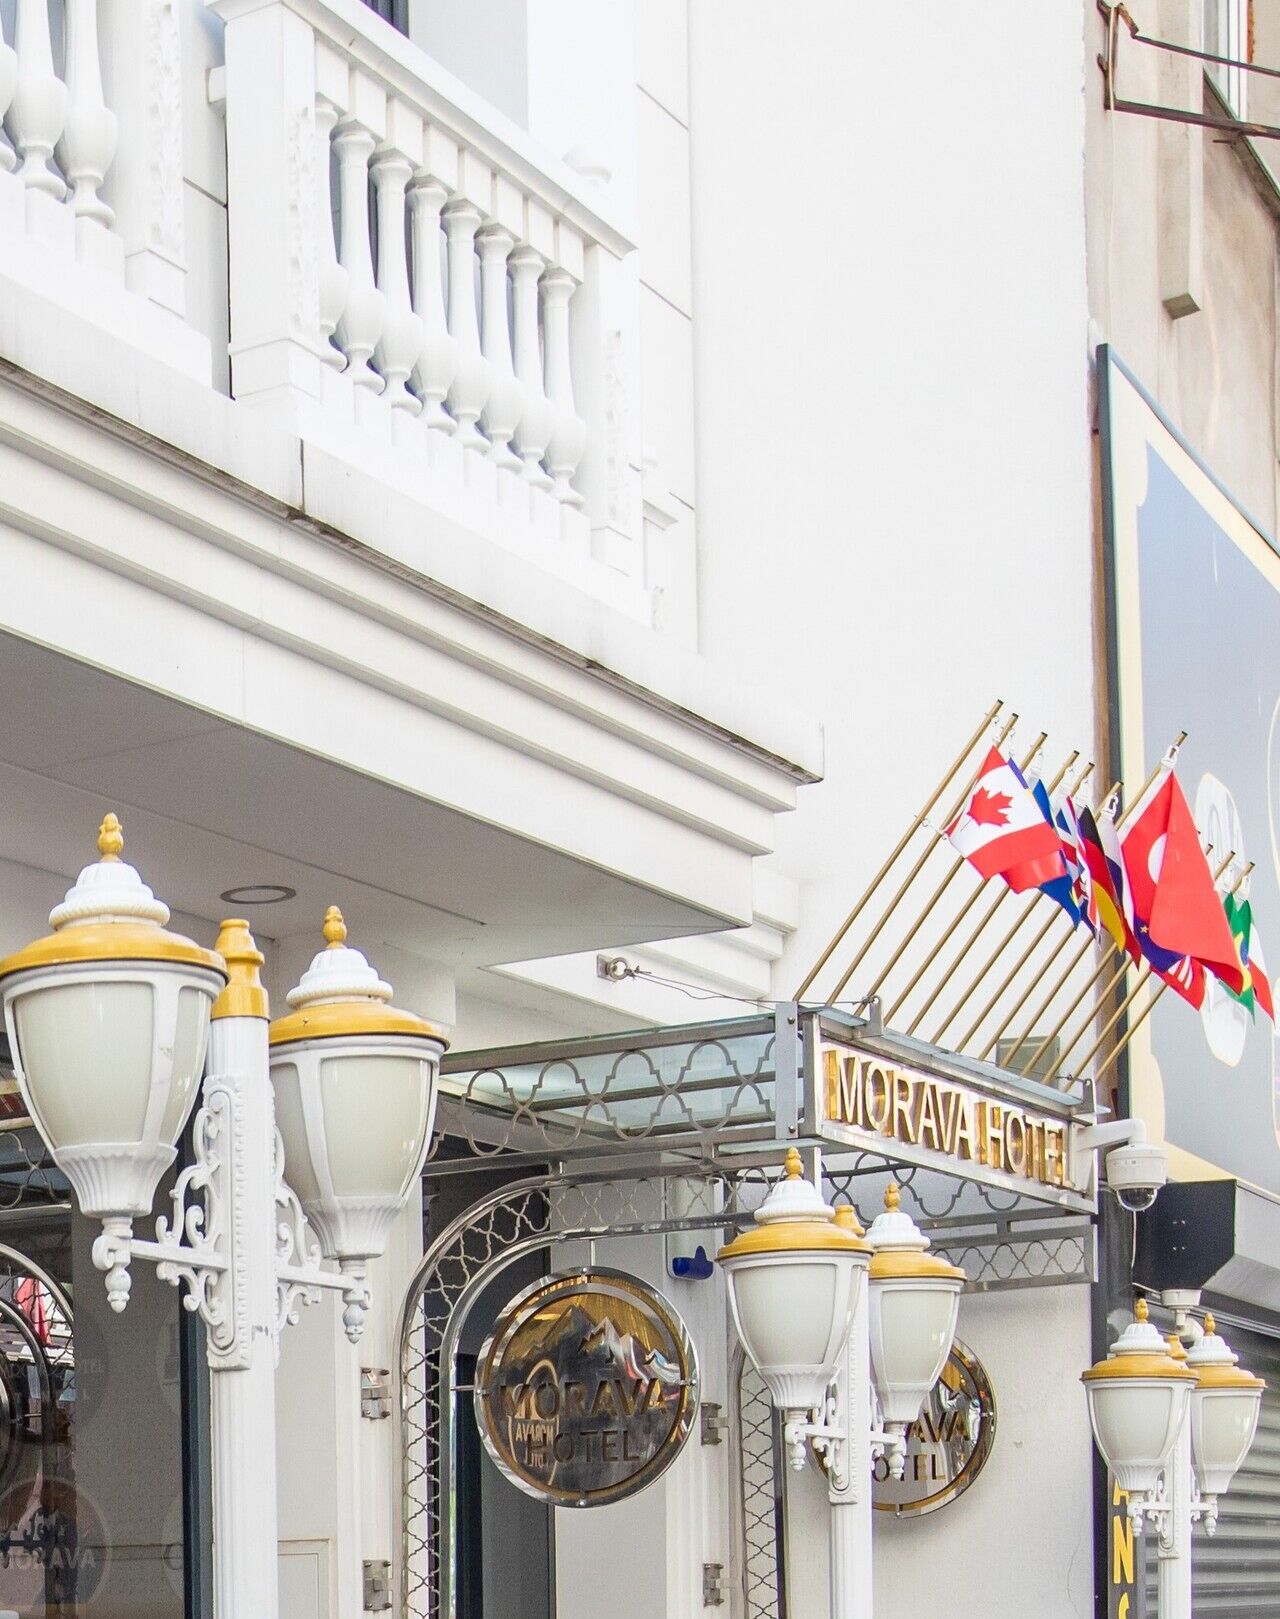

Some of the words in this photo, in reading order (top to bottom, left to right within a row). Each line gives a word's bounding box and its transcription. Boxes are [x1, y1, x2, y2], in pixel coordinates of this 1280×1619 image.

[824, 1050, 975, 1160] MORAVA
[974, 1101, 1071, 1187] HOTEL
[499, 1377, 667, 1420] MORAVA
[526, 1429, 641, 1463] HOTEL
